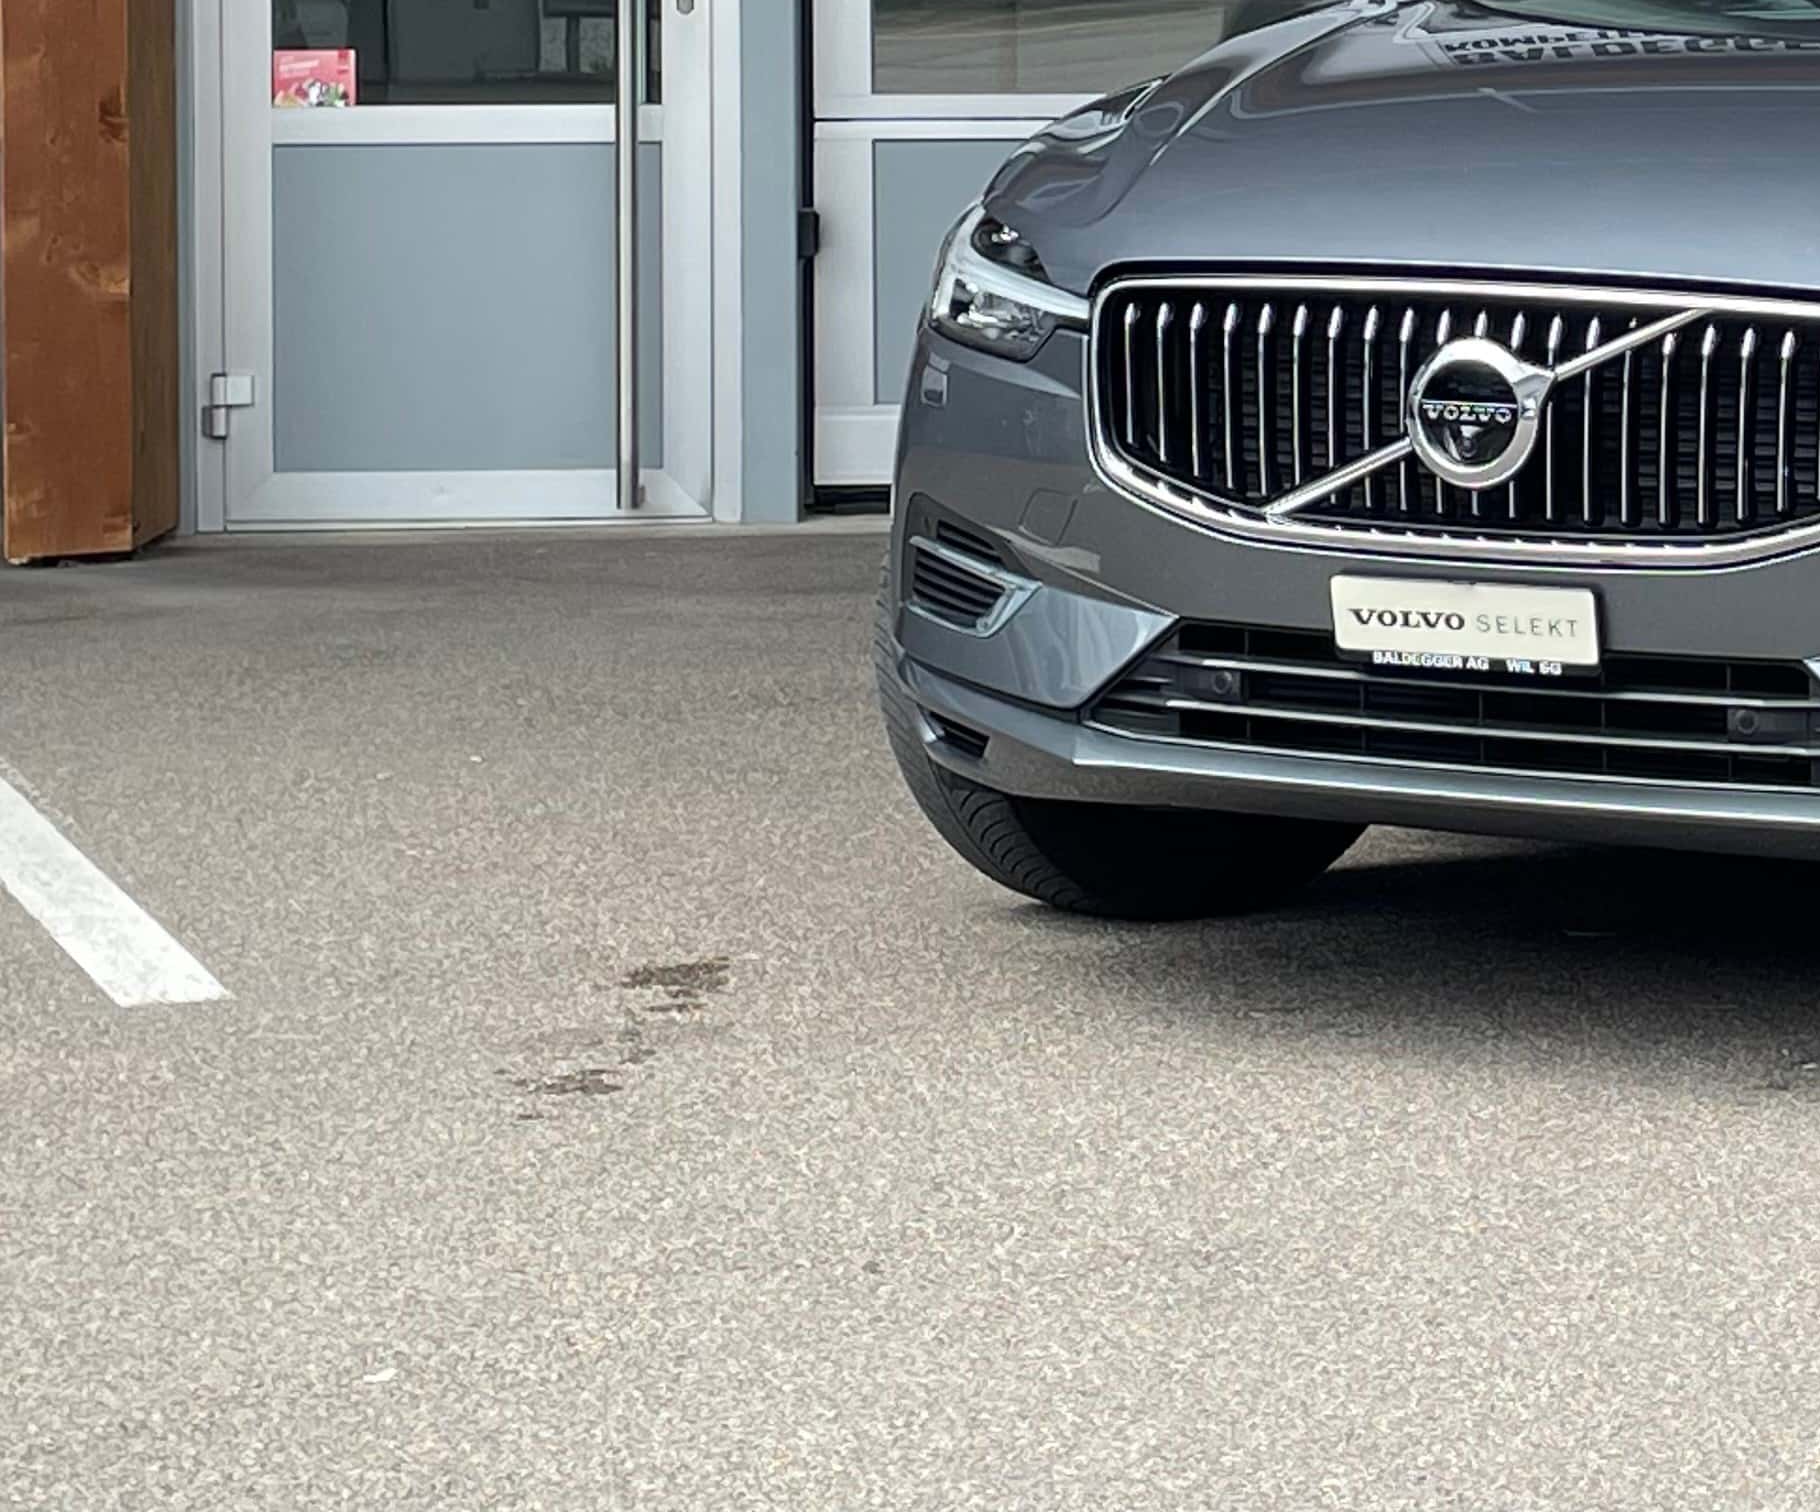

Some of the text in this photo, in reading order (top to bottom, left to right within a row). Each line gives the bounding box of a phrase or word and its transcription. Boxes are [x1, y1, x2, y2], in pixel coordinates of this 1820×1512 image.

[1422, 403, 1513, 424] VOLVO
[1348, 607, 1579, 638] VOLVO SELEKT
[1465, 655, 1490, 671] AG
